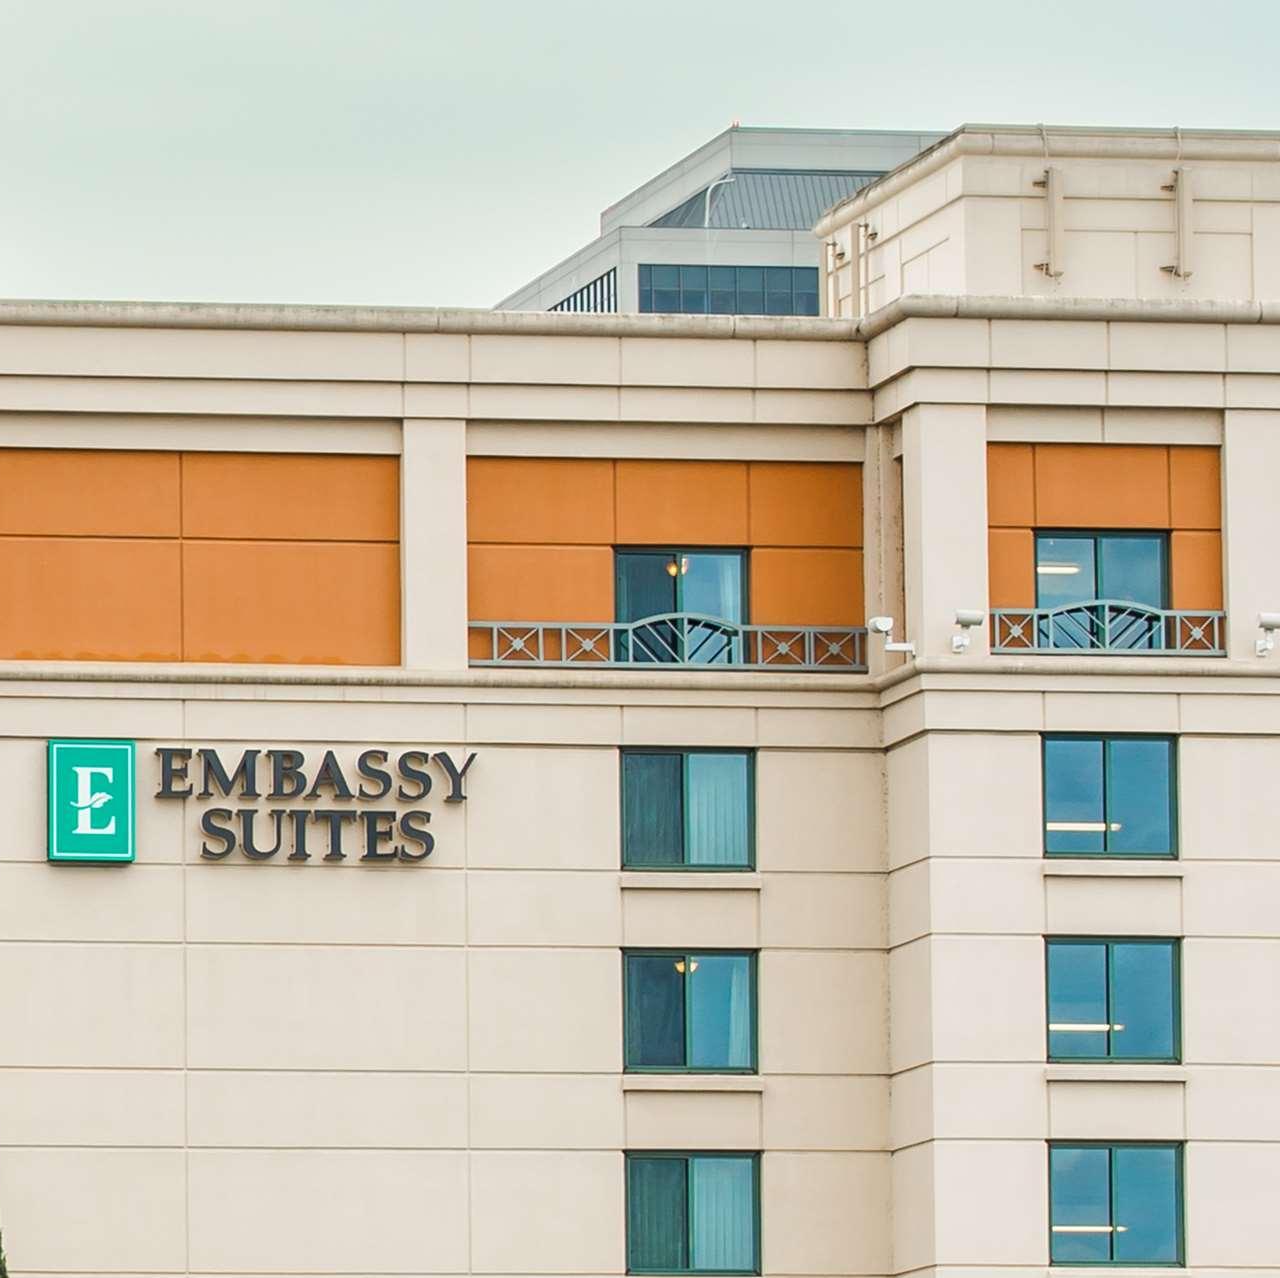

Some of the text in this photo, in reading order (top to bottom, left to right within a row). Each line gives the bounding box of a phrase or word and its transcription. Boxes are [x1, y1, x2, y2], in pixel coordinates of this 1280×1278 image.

[70, 766, 116, 835] E
[154, 747, 478, 803] EMBASSY
[200, 808, 435, 863] SUITES
